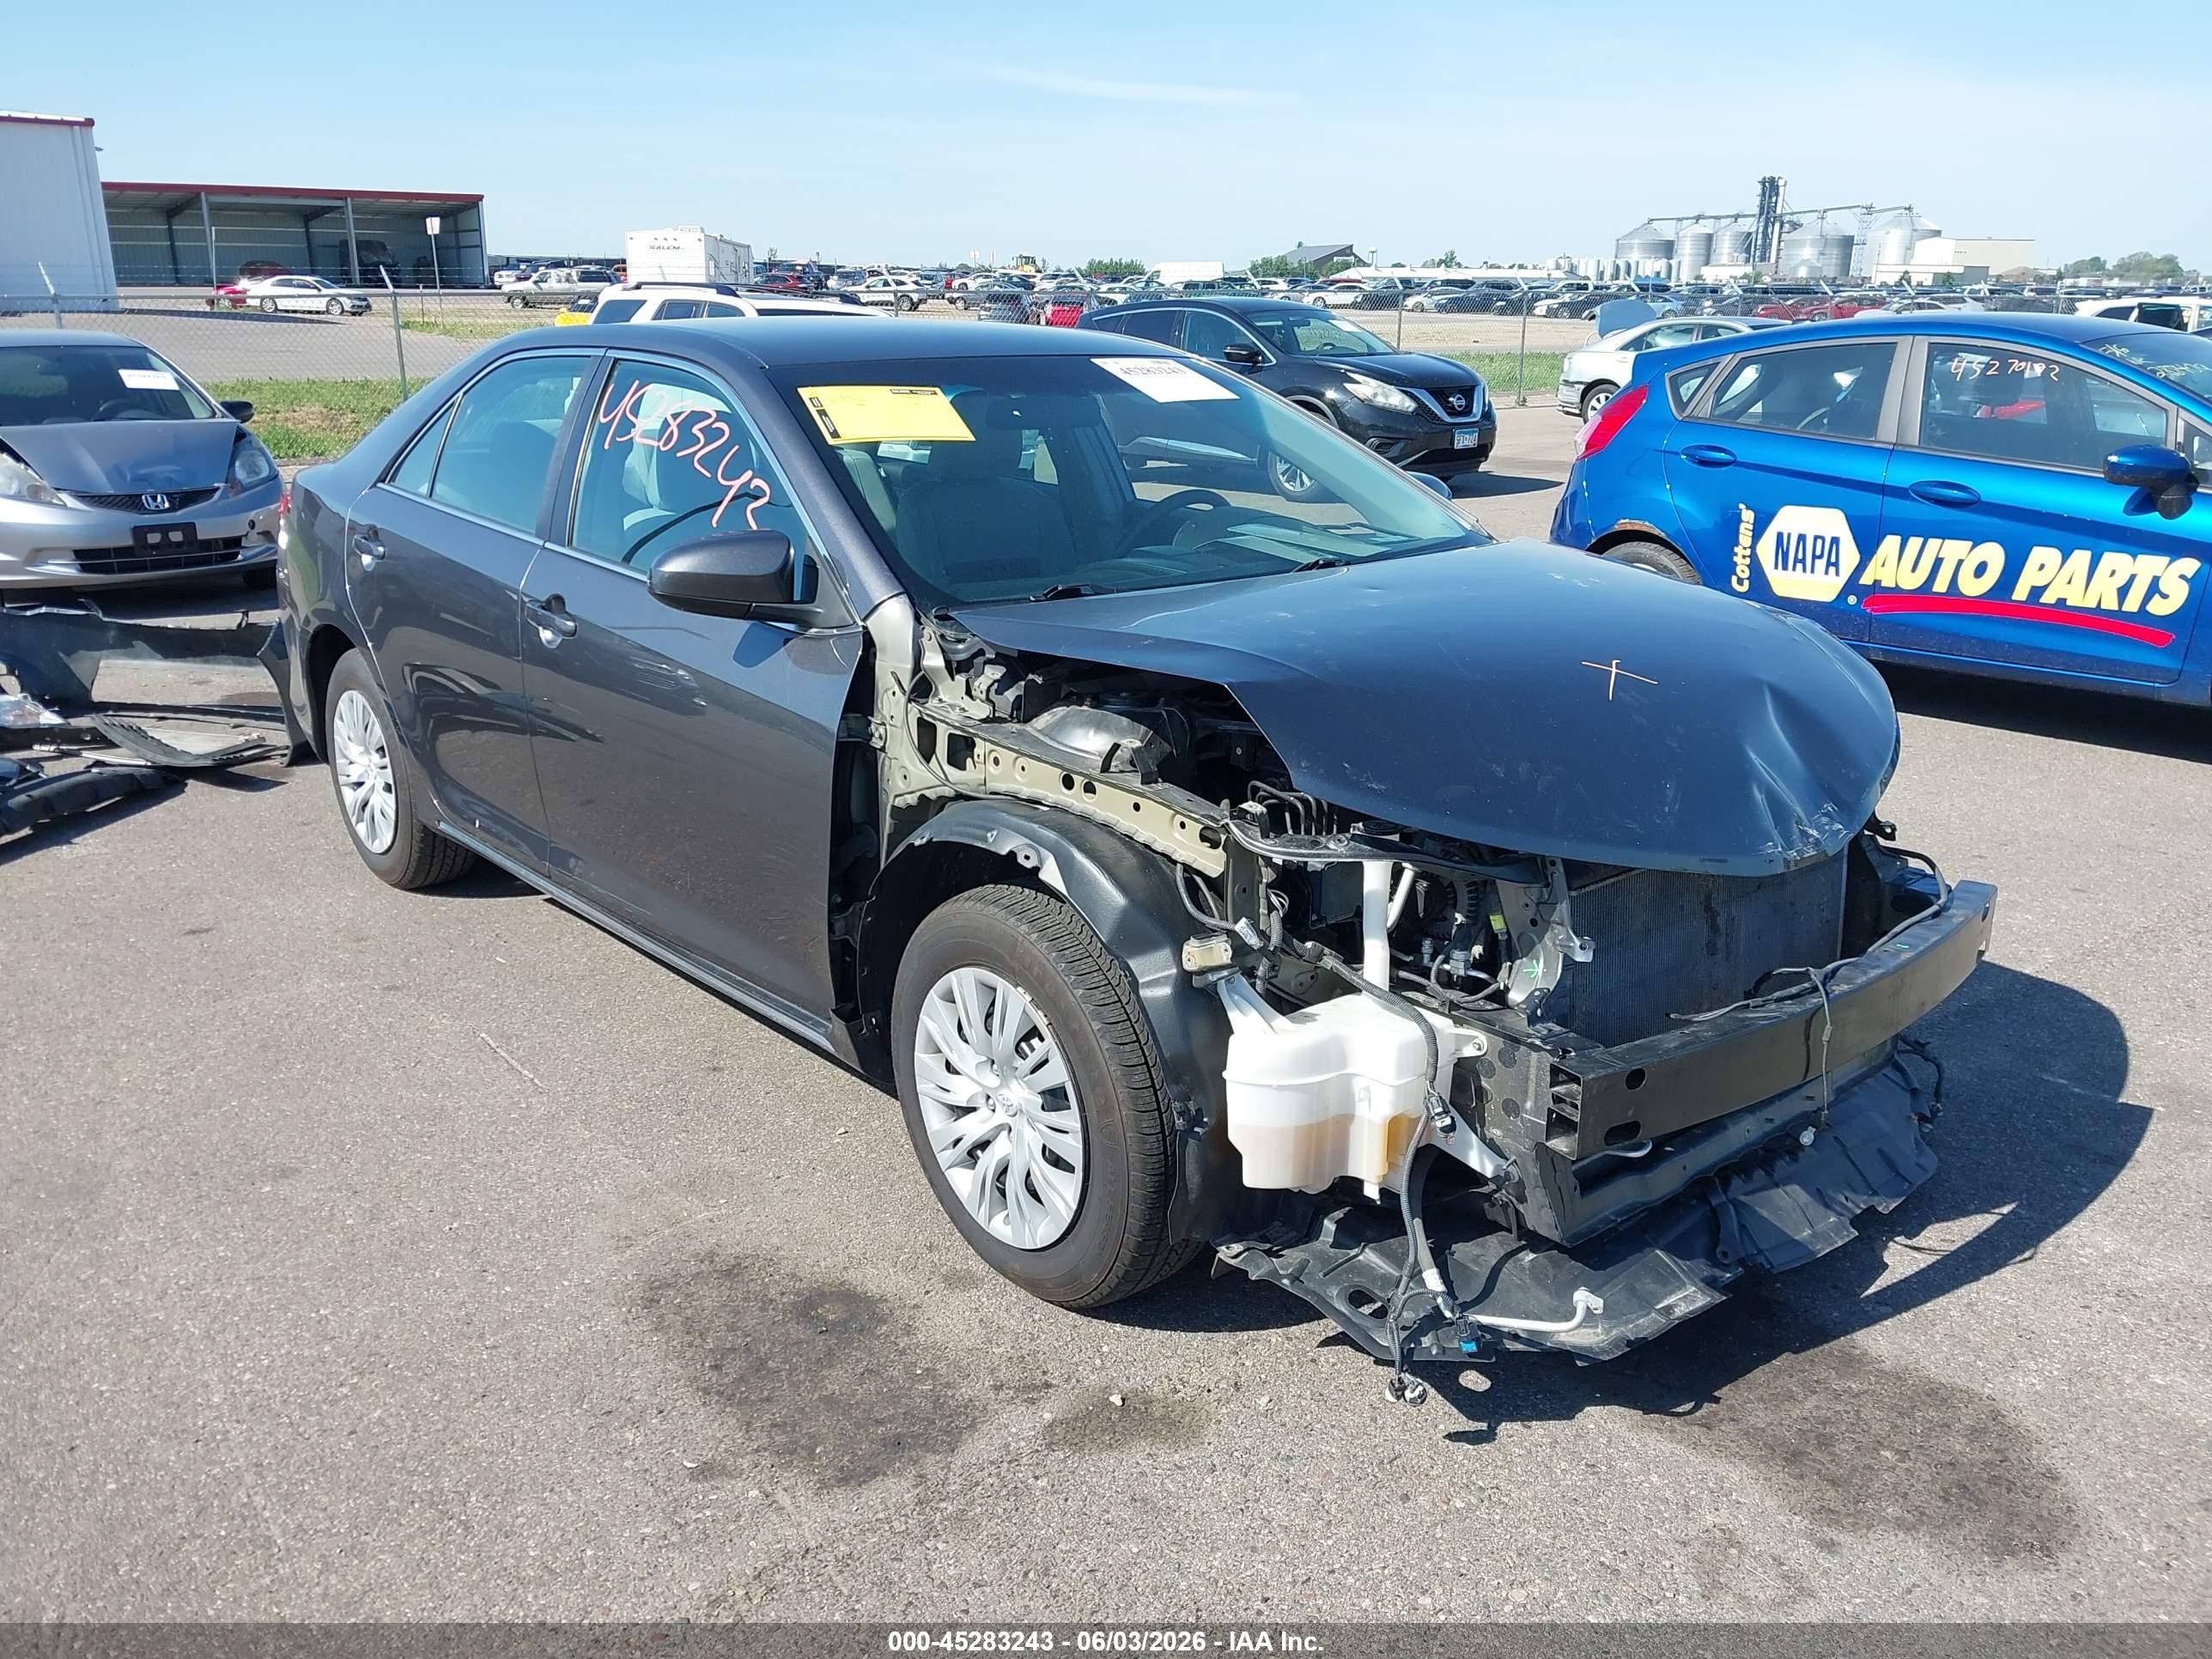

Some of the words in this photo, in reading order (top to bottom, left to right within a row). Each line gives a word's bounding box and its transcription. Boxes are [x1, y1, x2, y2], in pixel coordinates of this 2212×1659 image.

[1731, 502, 1754, 592] Cottens'
[1773, 532, 1840, 577] NAPA
[1858, 534, 2006, 597] AUTO
[2011, 545, 2202, 617] PARTS
